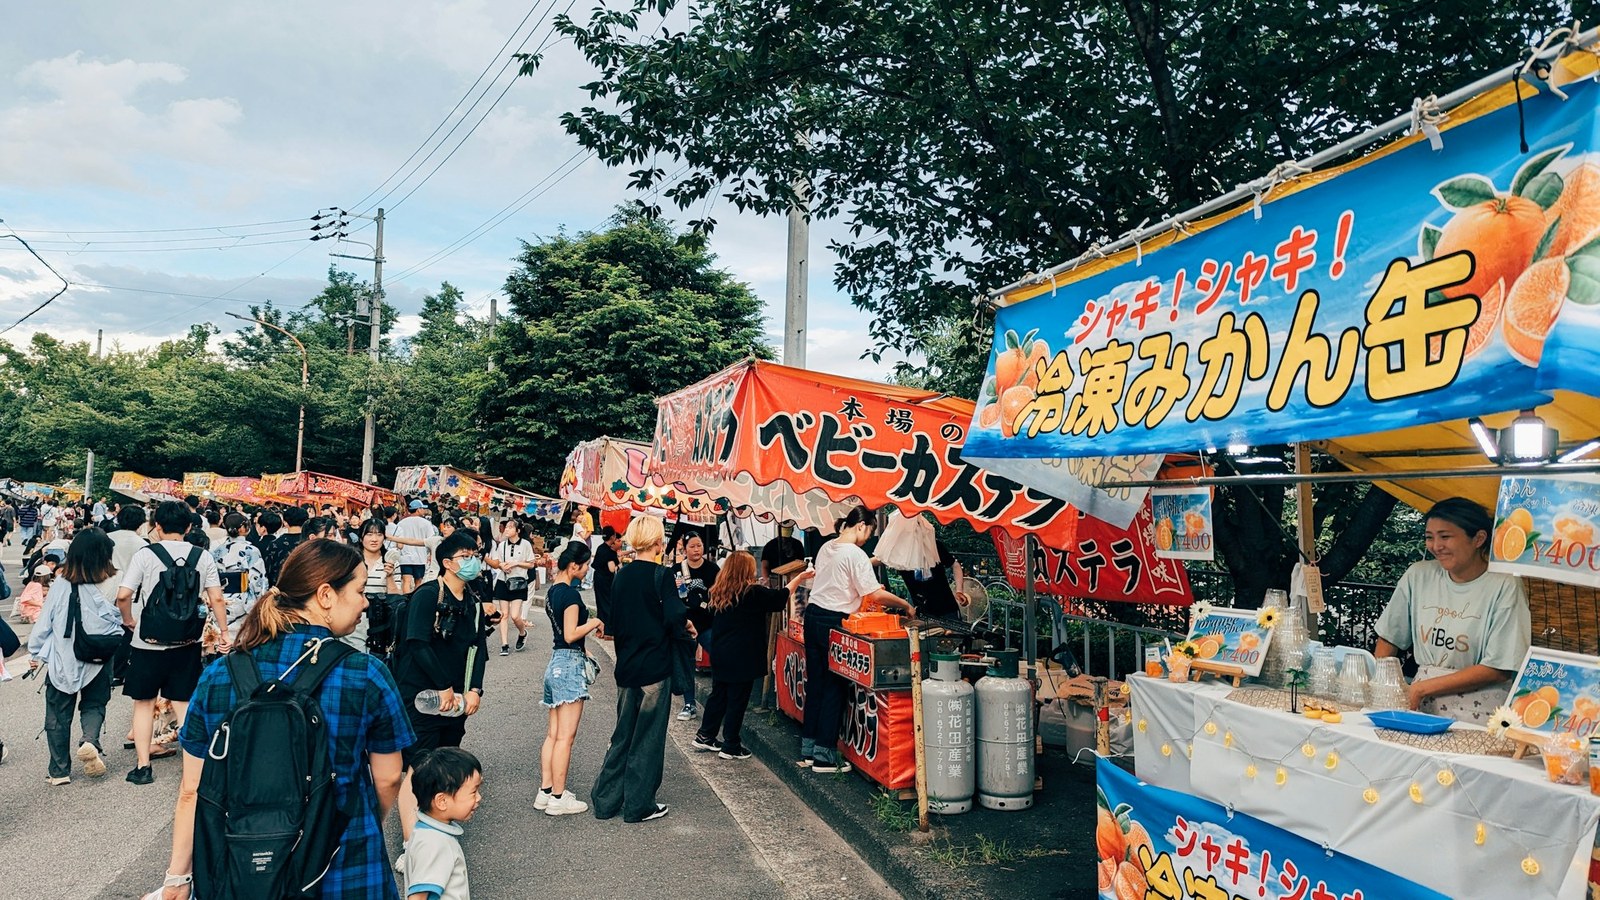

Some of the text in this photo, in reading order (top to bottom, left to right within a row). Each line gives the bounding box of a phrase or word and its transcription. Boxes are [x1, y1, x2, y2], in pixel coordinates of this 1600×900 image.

[1012, 250, 1481, 438] 冷凍みかん缶
[838, 396, 964, 443] 本場の
[1423, 602, 1481, 624] good
